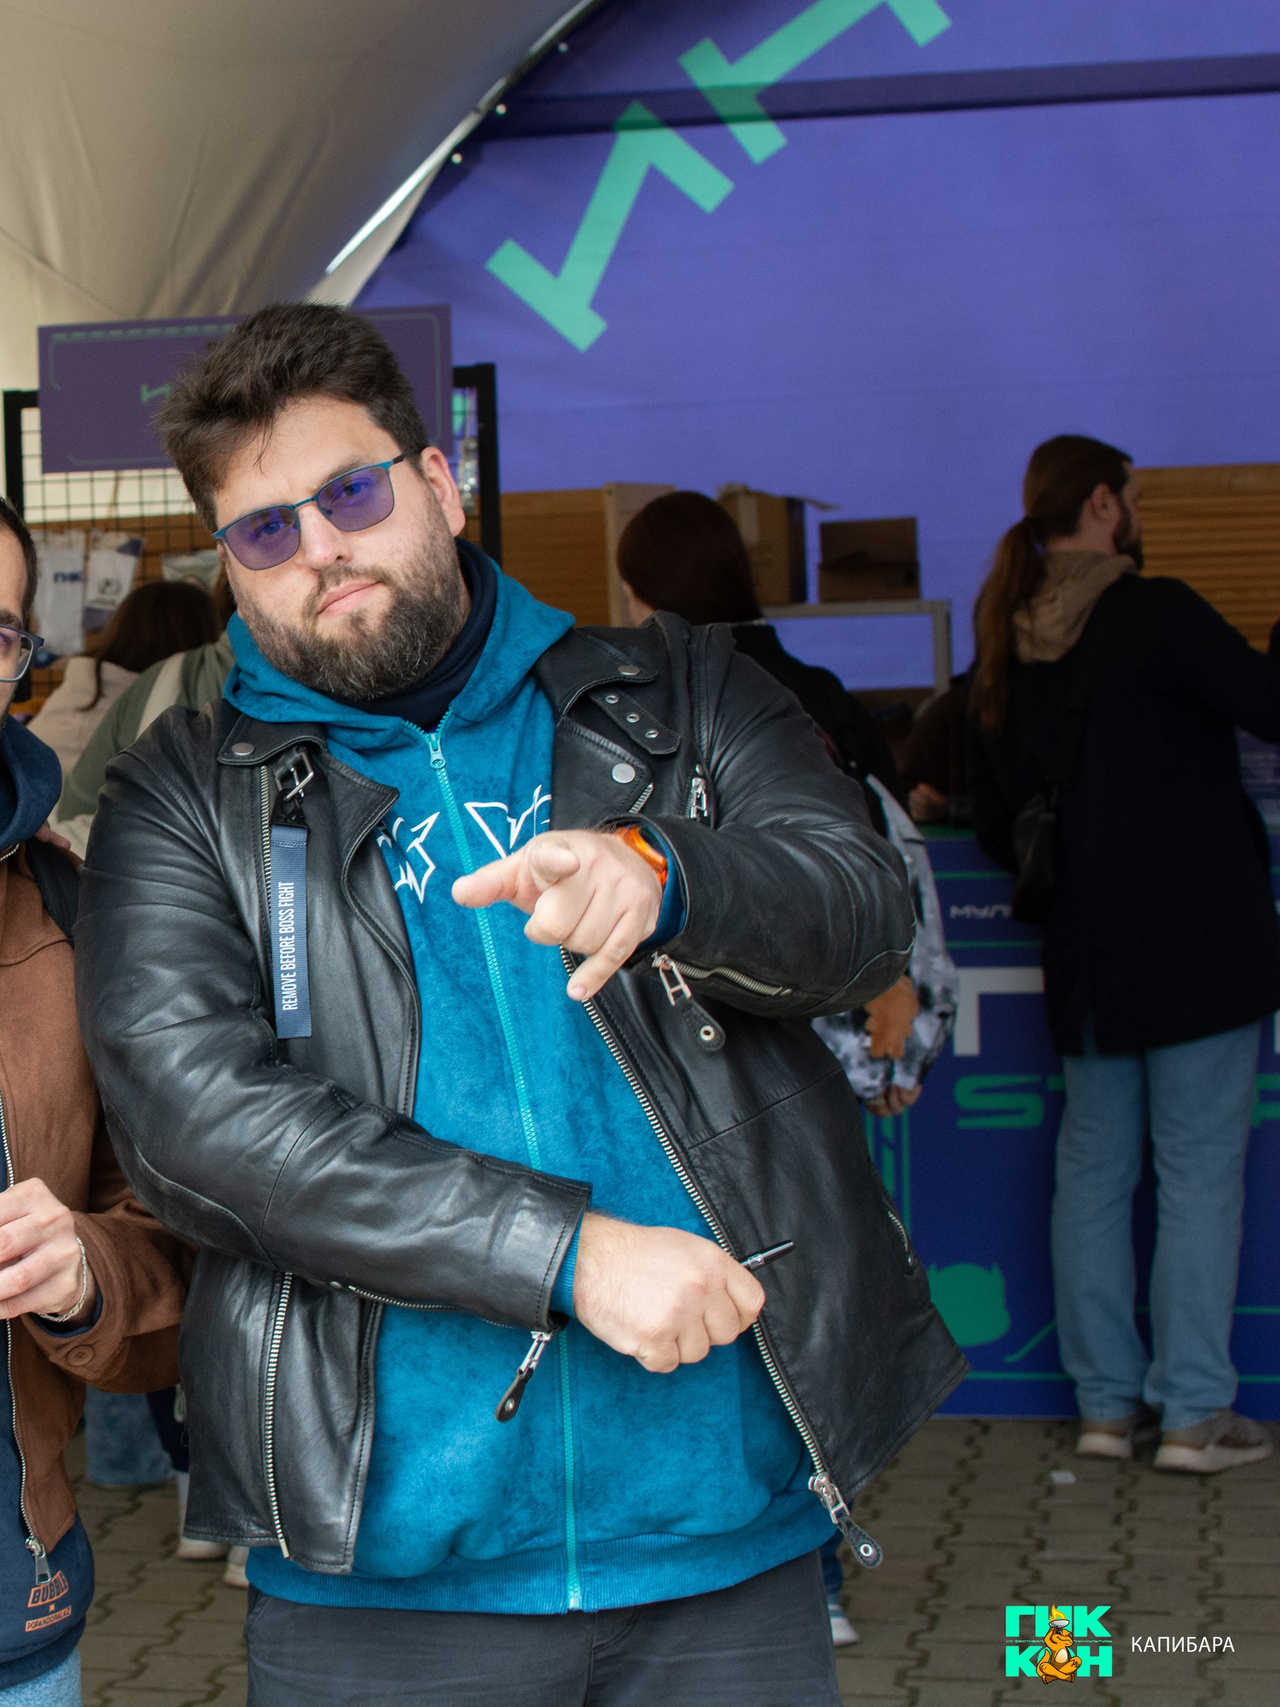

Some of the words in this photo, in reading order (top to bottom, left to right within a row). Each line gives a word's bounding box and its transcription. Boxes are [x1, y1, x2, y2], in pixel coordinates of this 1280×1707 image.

[278, 881, 295, 907] FIGHT
[278, 908, 295, 933] BOSS
[279, 934, 296, 971] BEFORE
[281, 971, 298, 1011] REMOVE
[29, 1572, 69, 1606] BUBBLE
